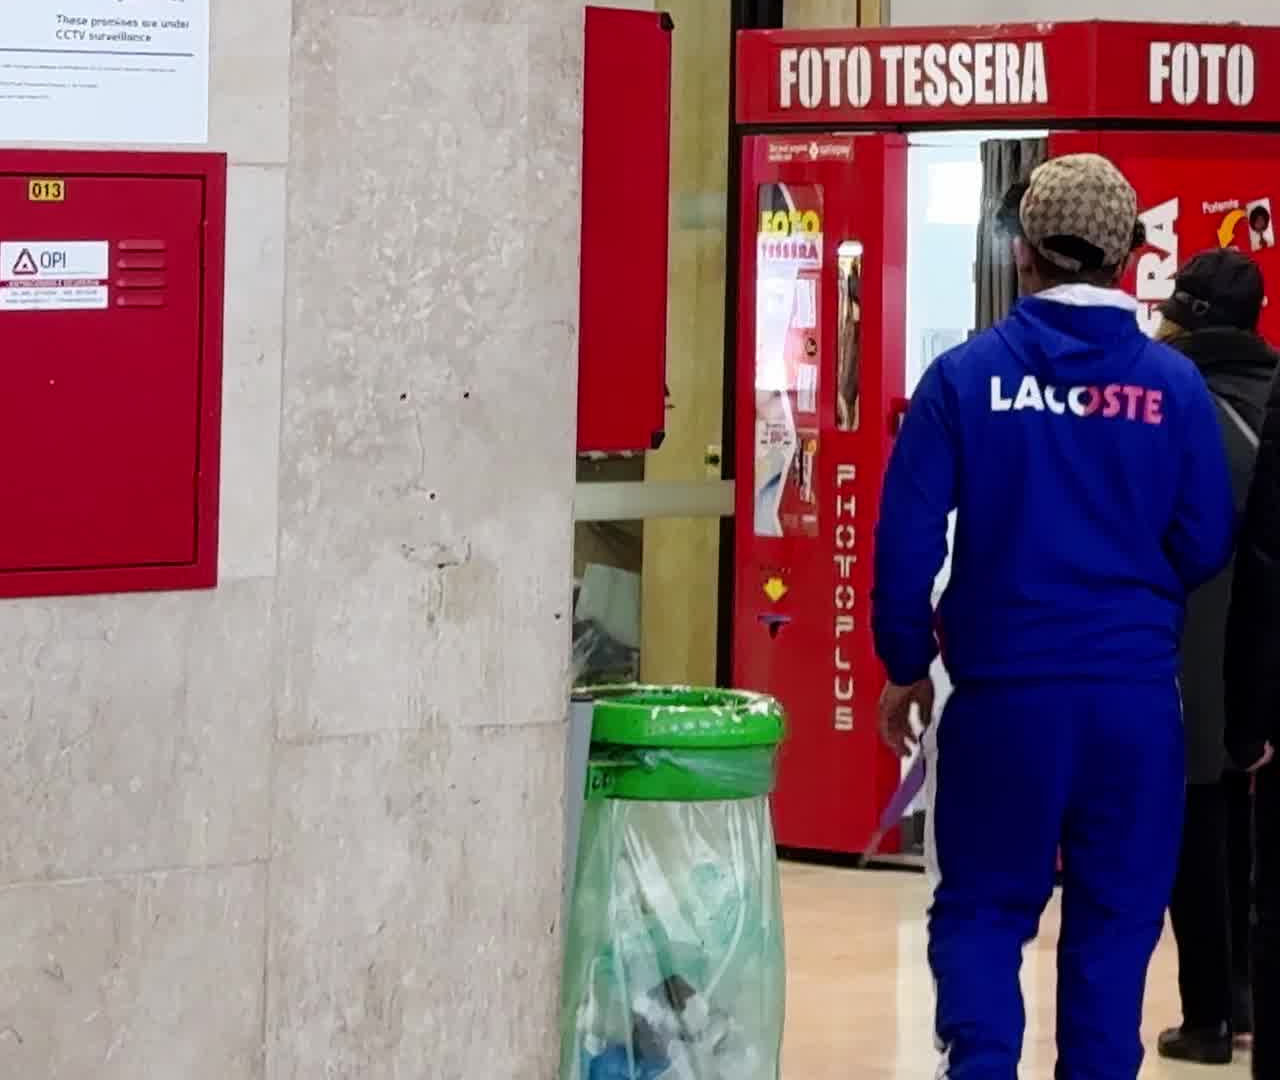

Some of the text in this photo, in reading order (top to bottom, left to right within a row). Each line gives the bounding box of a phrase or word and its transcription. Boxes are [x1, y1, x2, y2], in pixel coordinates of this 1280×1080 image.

[56, 14, 88, 26] These
[56, 30, 152, 42] CCTV surveillance
[779, 42, 1049, 109] FOTO TESSERA
[1148, 42, 1255, 107] FOTO
[31, 182, 62, 199] 013
[40, 250, 67, 269] OPI
[990, 375, 1164, 424] LACOSTE
[833, 464, 857, 732] PHOTOPLUS
